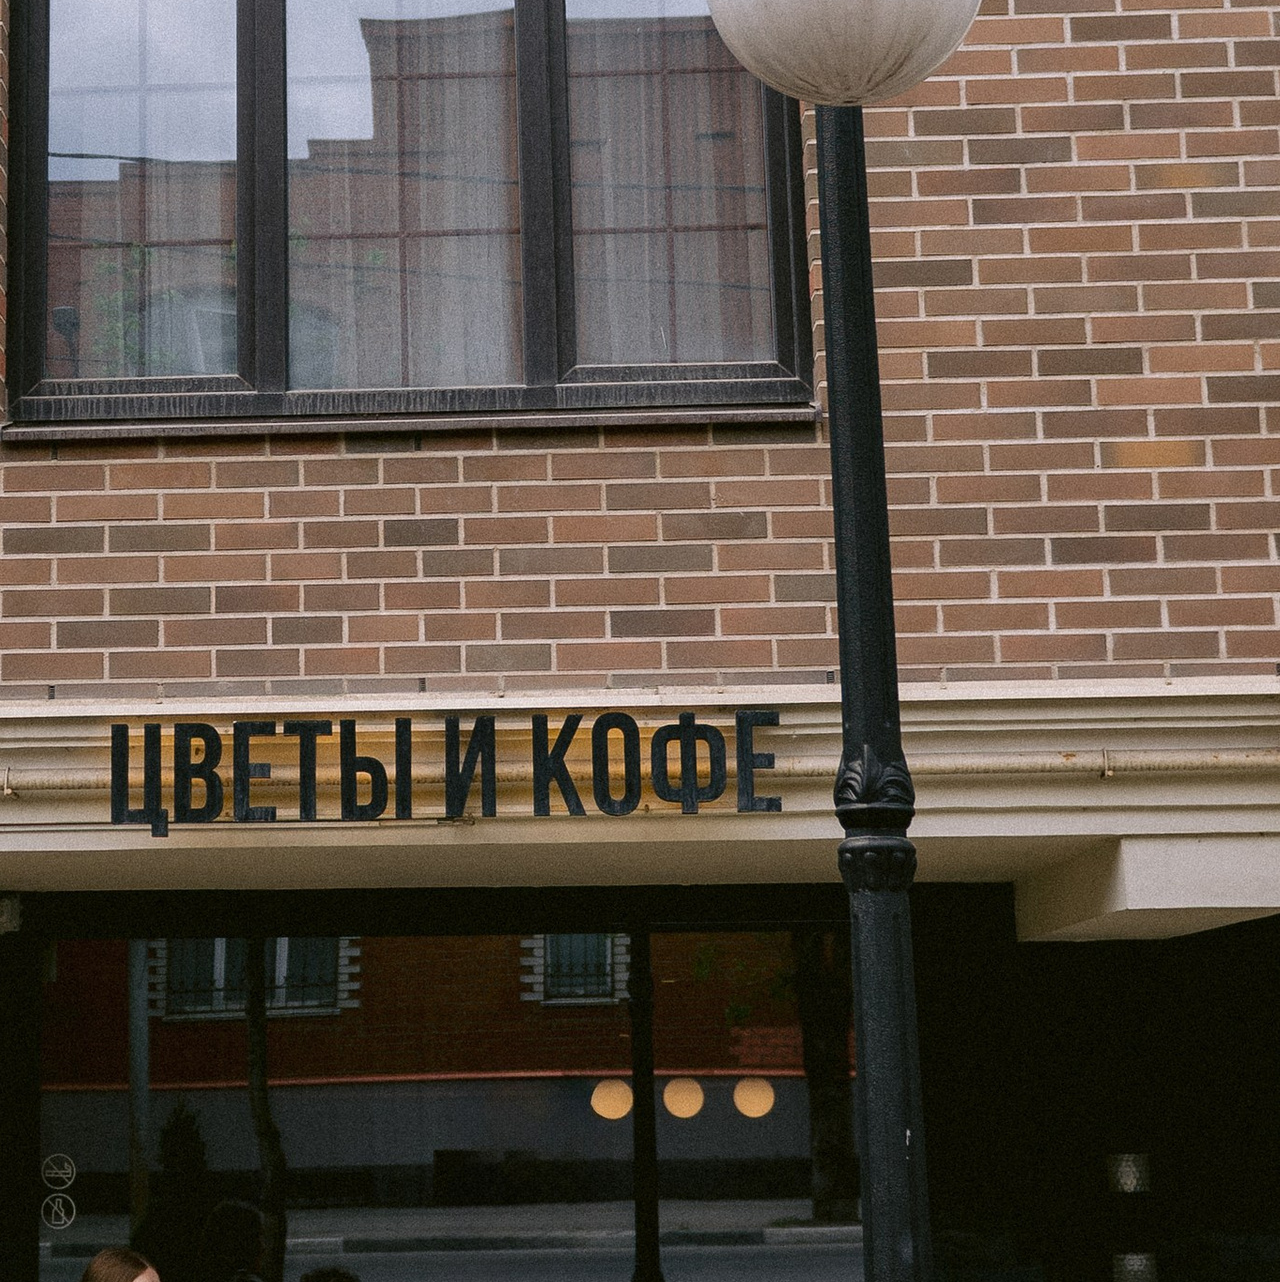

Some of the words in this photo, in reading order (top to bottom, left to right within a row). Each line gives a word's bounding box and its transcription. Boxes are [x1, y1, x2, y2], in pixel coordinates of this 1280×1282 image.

[110, 717, 413, 837] ЦВЕТЫ
[444, 715, 496, 818] И
[531, 710, 783, 817] КОФЕ
